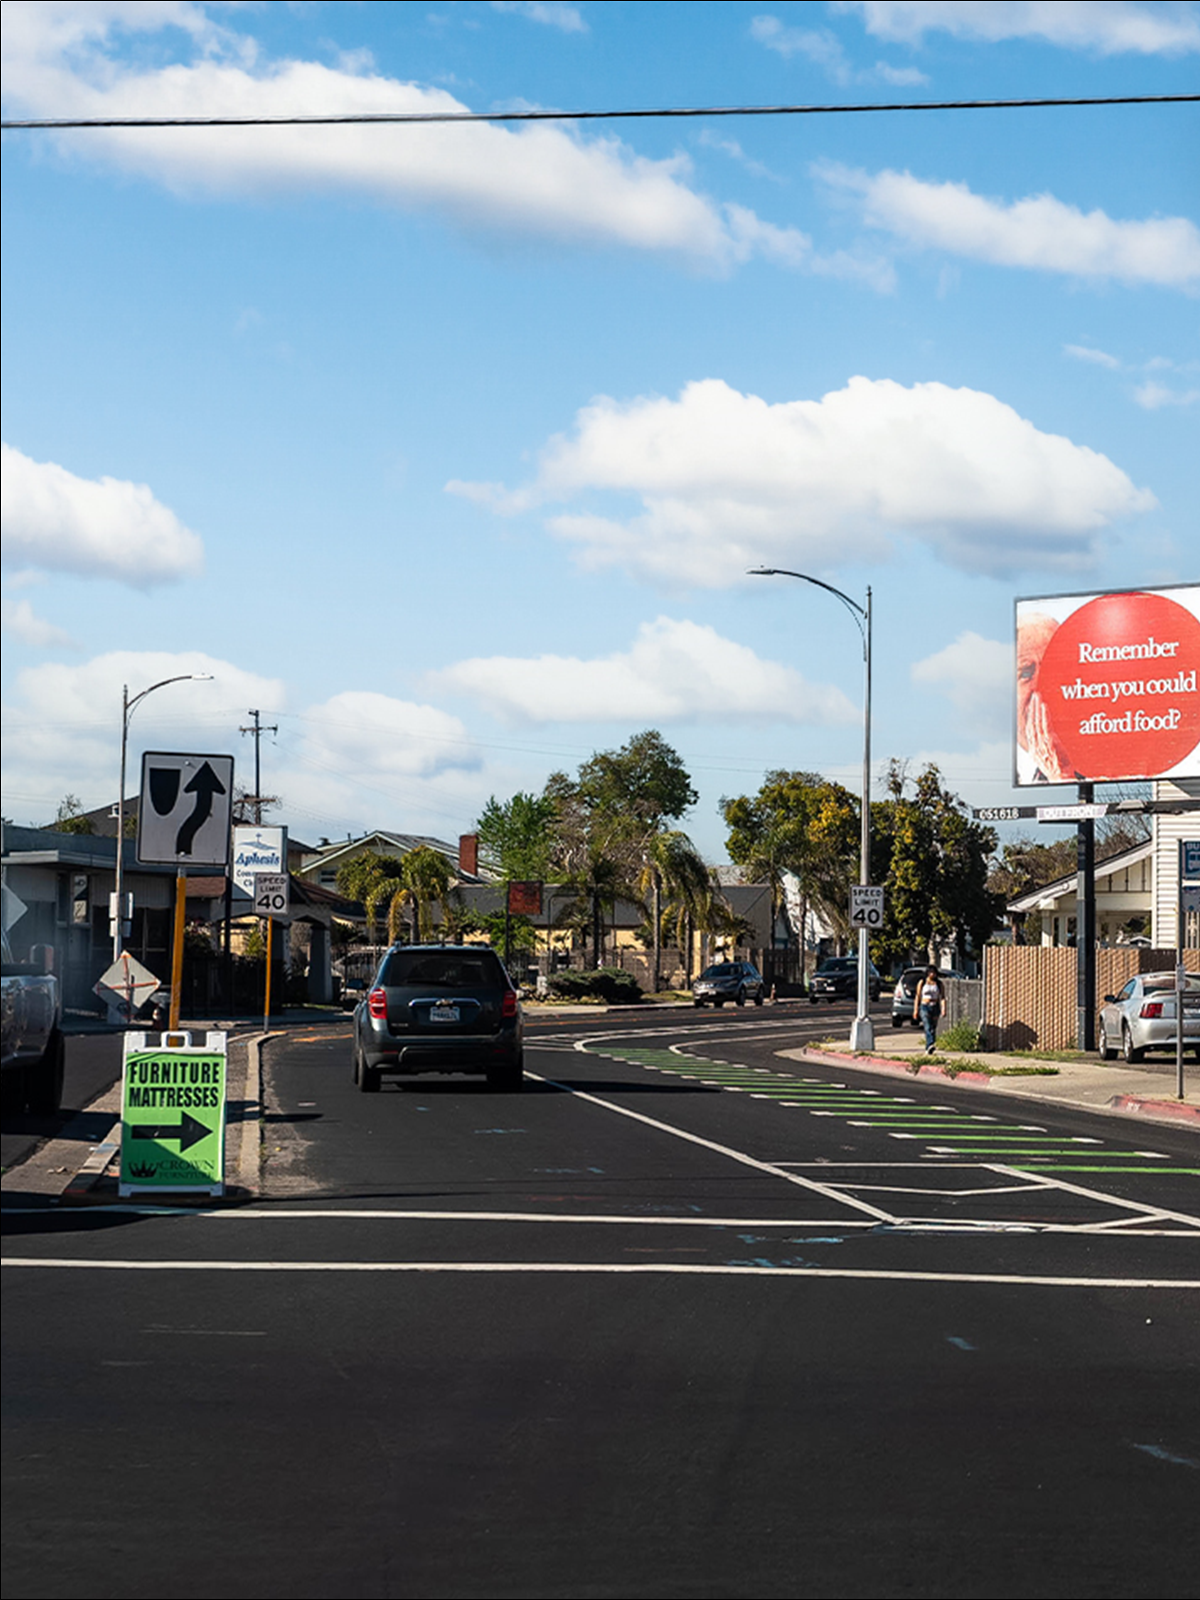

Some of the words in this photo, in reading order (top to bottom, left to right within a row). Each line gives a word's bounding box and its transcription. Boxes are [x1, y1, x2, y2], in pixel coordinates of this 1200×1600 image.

[1078, 637, 1180, 664] Remember
[1061, 677, 1110, 700] when
[1110, 680, 1146, 703] you
[1146, 670, 1198, 695] could
[1079, 709, 1132, 735] afford
[1133, 707, 1182, 732] food?
[235, 852, 280, 866] Aphesis
[258, 877, 286, 885] SPEED
[260, 885, 281, 893] LIMIT
[853, 888, 883, 897] SPEED
[257, 894, 285, 909] 40
[854, 899, 879, 907] LIMIT
[853, 908, 880, 924] 40
[130, 1062, 220, 1083] FURNITURE
[129, 1086, 218, 1107] MATTRESSES
[159, 1160, 215, 1170] CROWN
